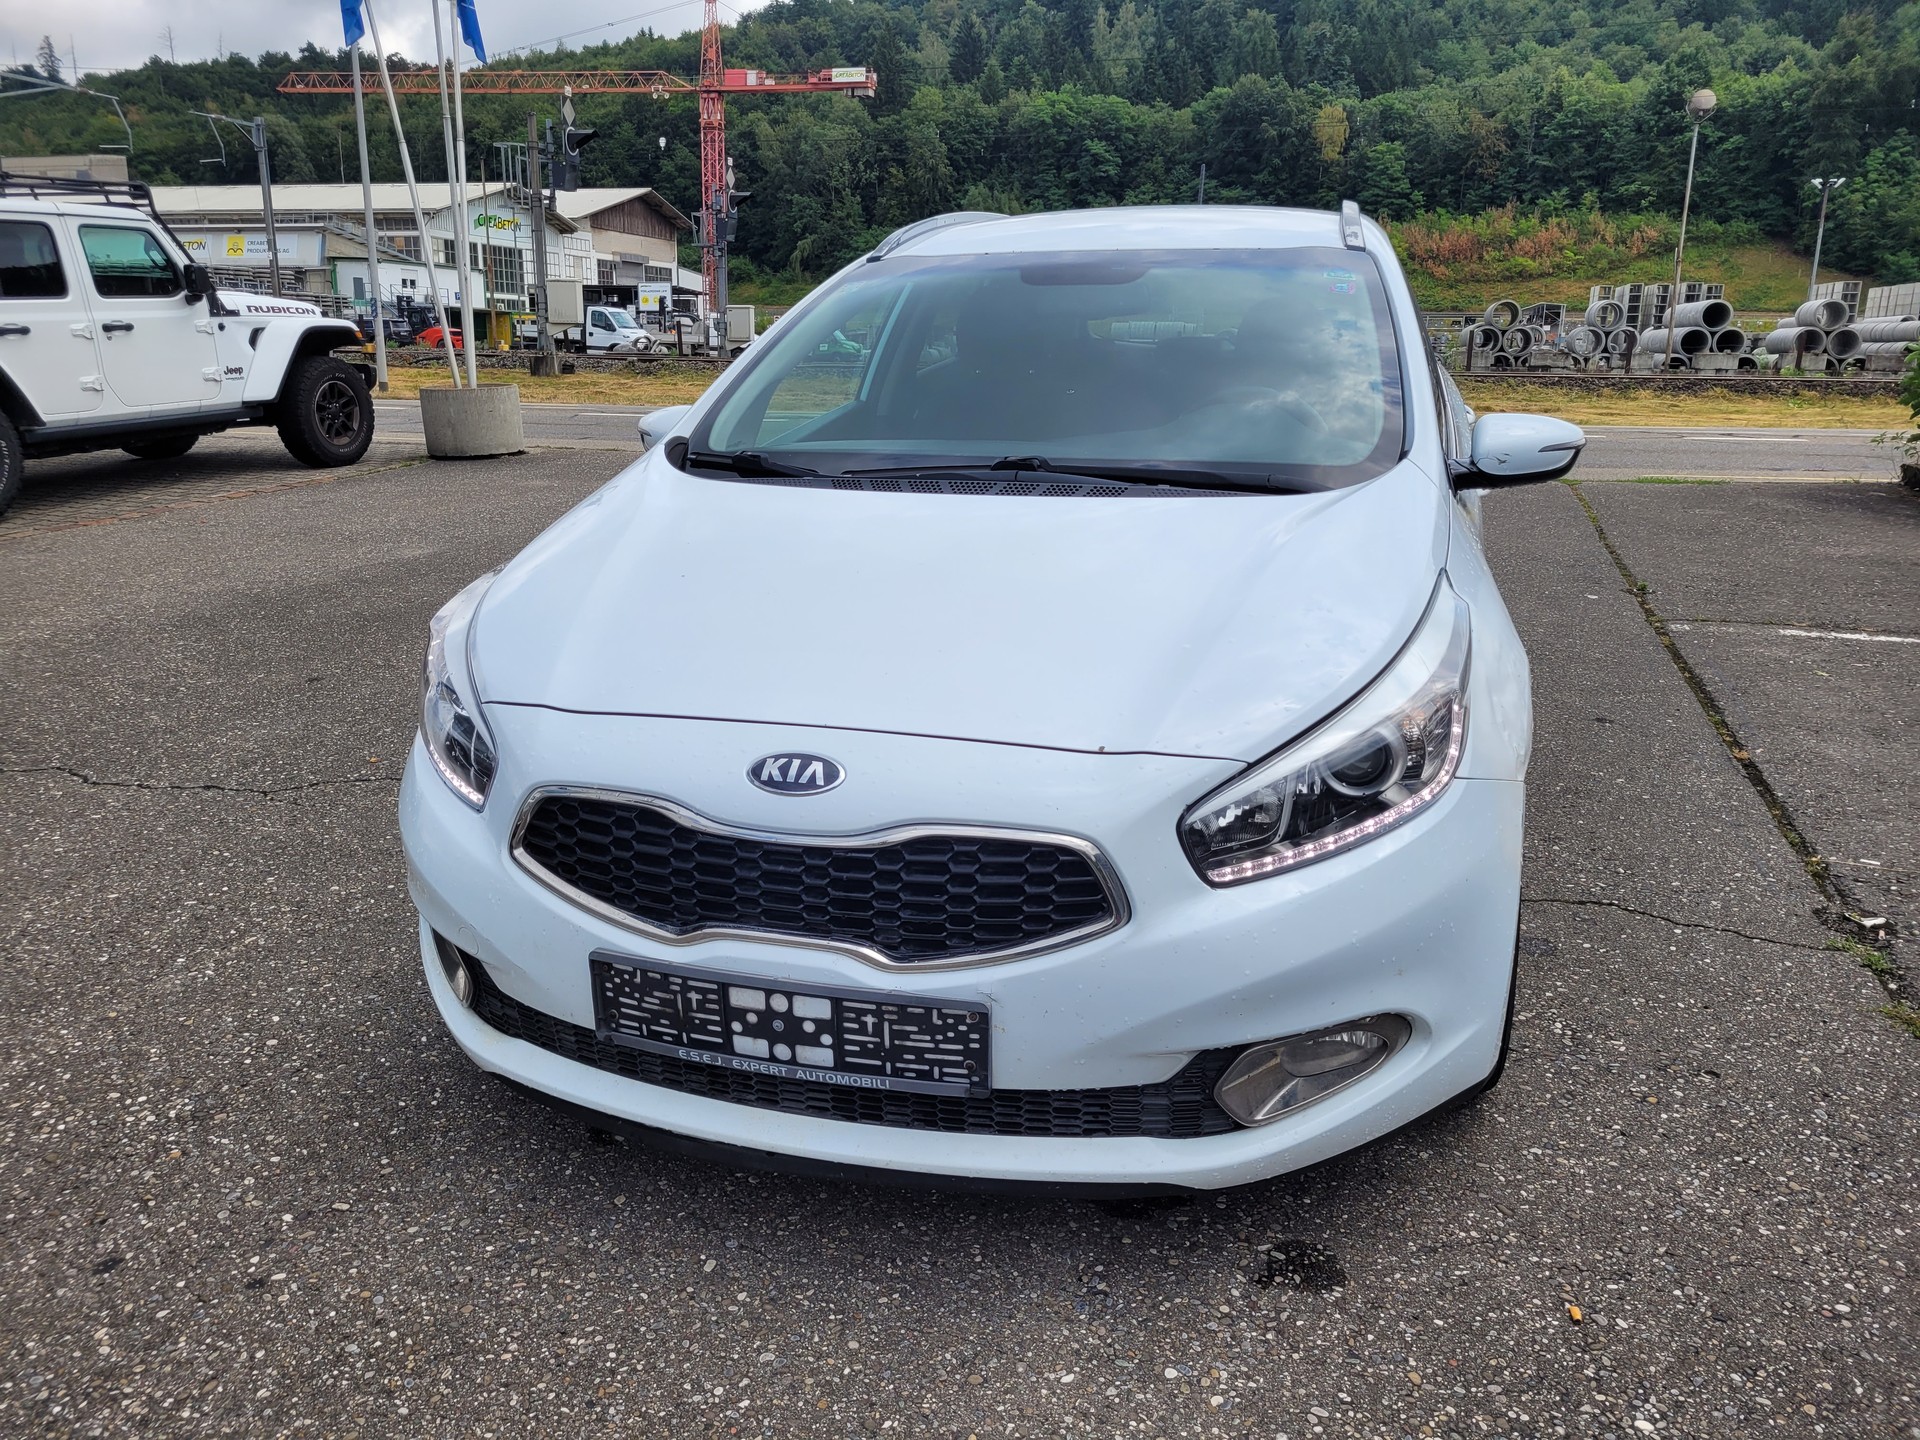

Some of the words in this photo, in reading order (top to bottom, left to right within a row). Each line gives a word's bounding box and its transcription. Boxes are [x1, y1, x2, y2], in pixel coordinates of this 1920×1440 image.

[246, 304, 317, 316] RUBICON
[223, 365, 244, 375] Jeep
[760, 757, 825, 786] KIA
[732, 1059, 788, 1078] EXPERT
[795, 1068, 890, 1090] AUTOMOBILI
